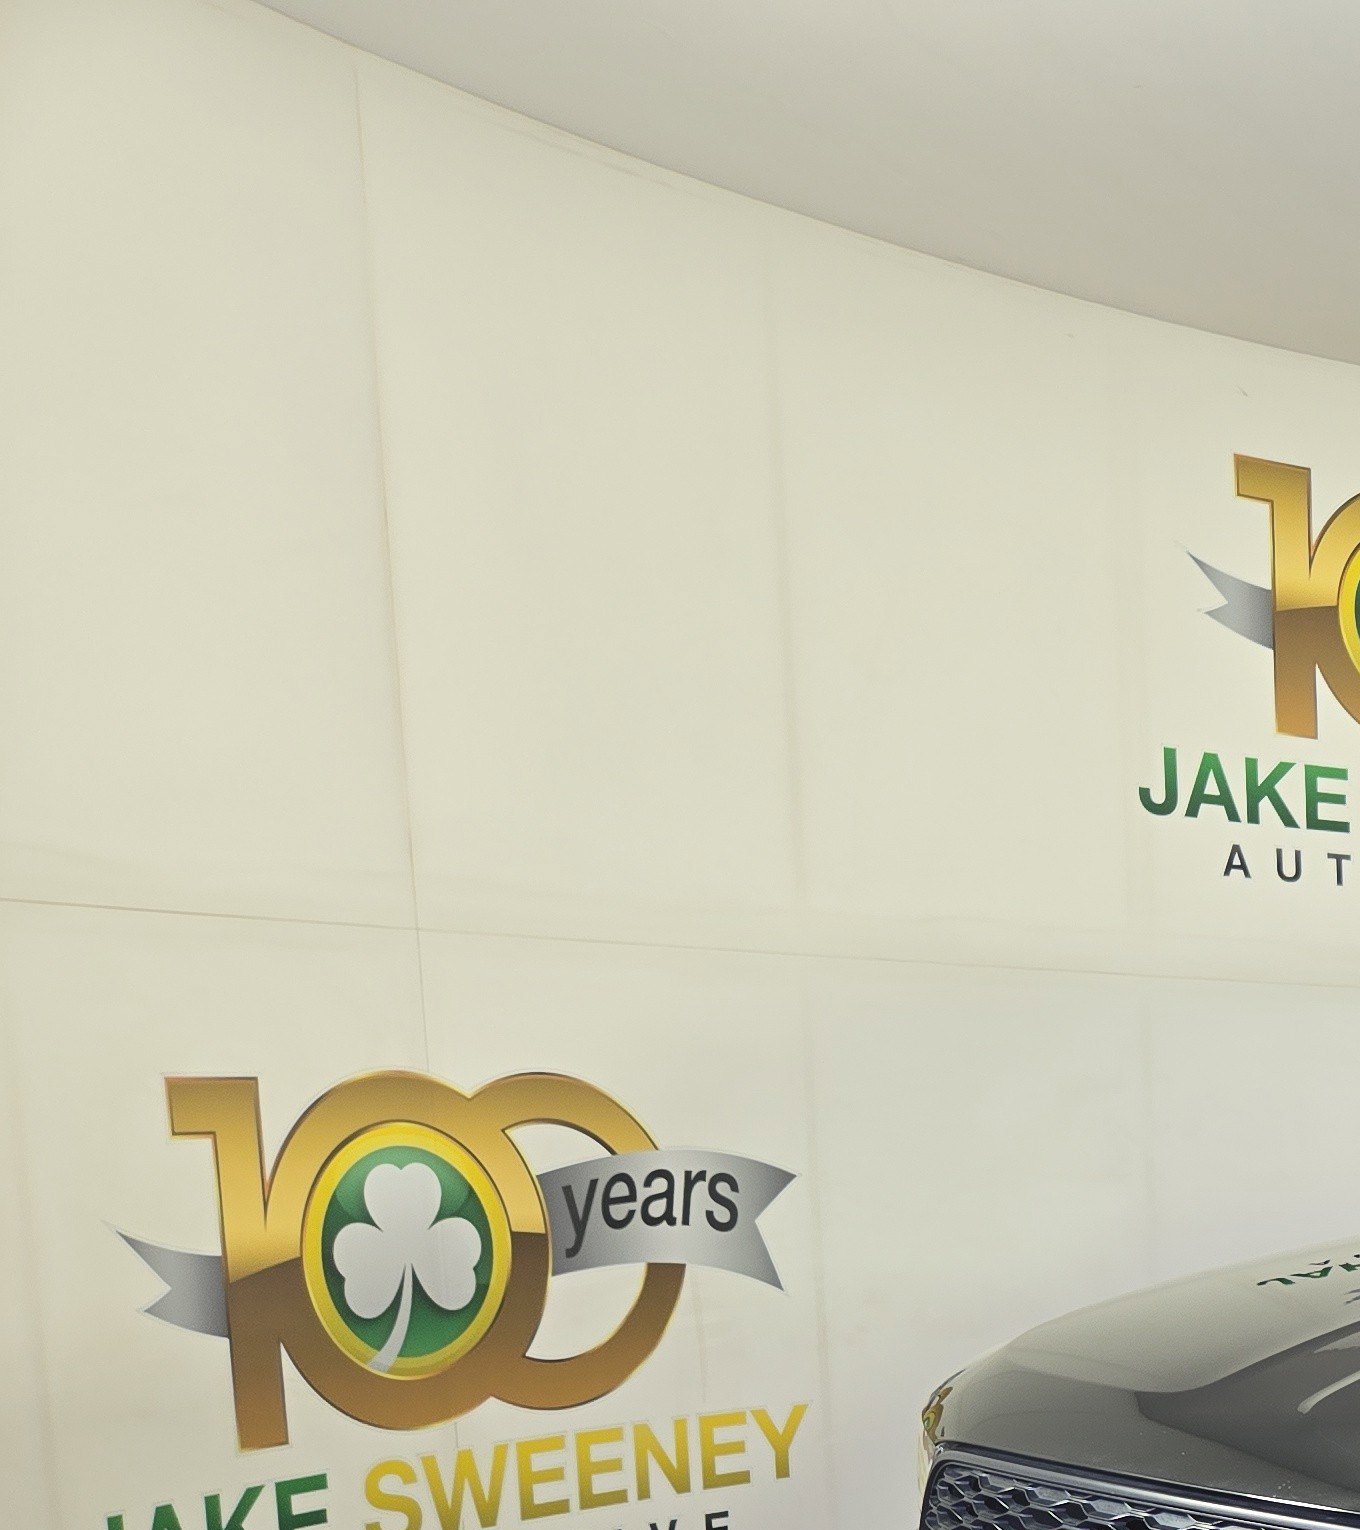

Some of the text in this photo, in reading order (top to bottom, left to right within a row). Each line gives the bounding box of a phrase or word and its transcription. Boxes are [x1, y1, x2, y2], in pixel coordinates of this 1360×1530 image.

[1138, 747, 1350, 833] JAKE
[562, 1168, 741, 1259] years
[164, 1070, 687, 1452] 100
